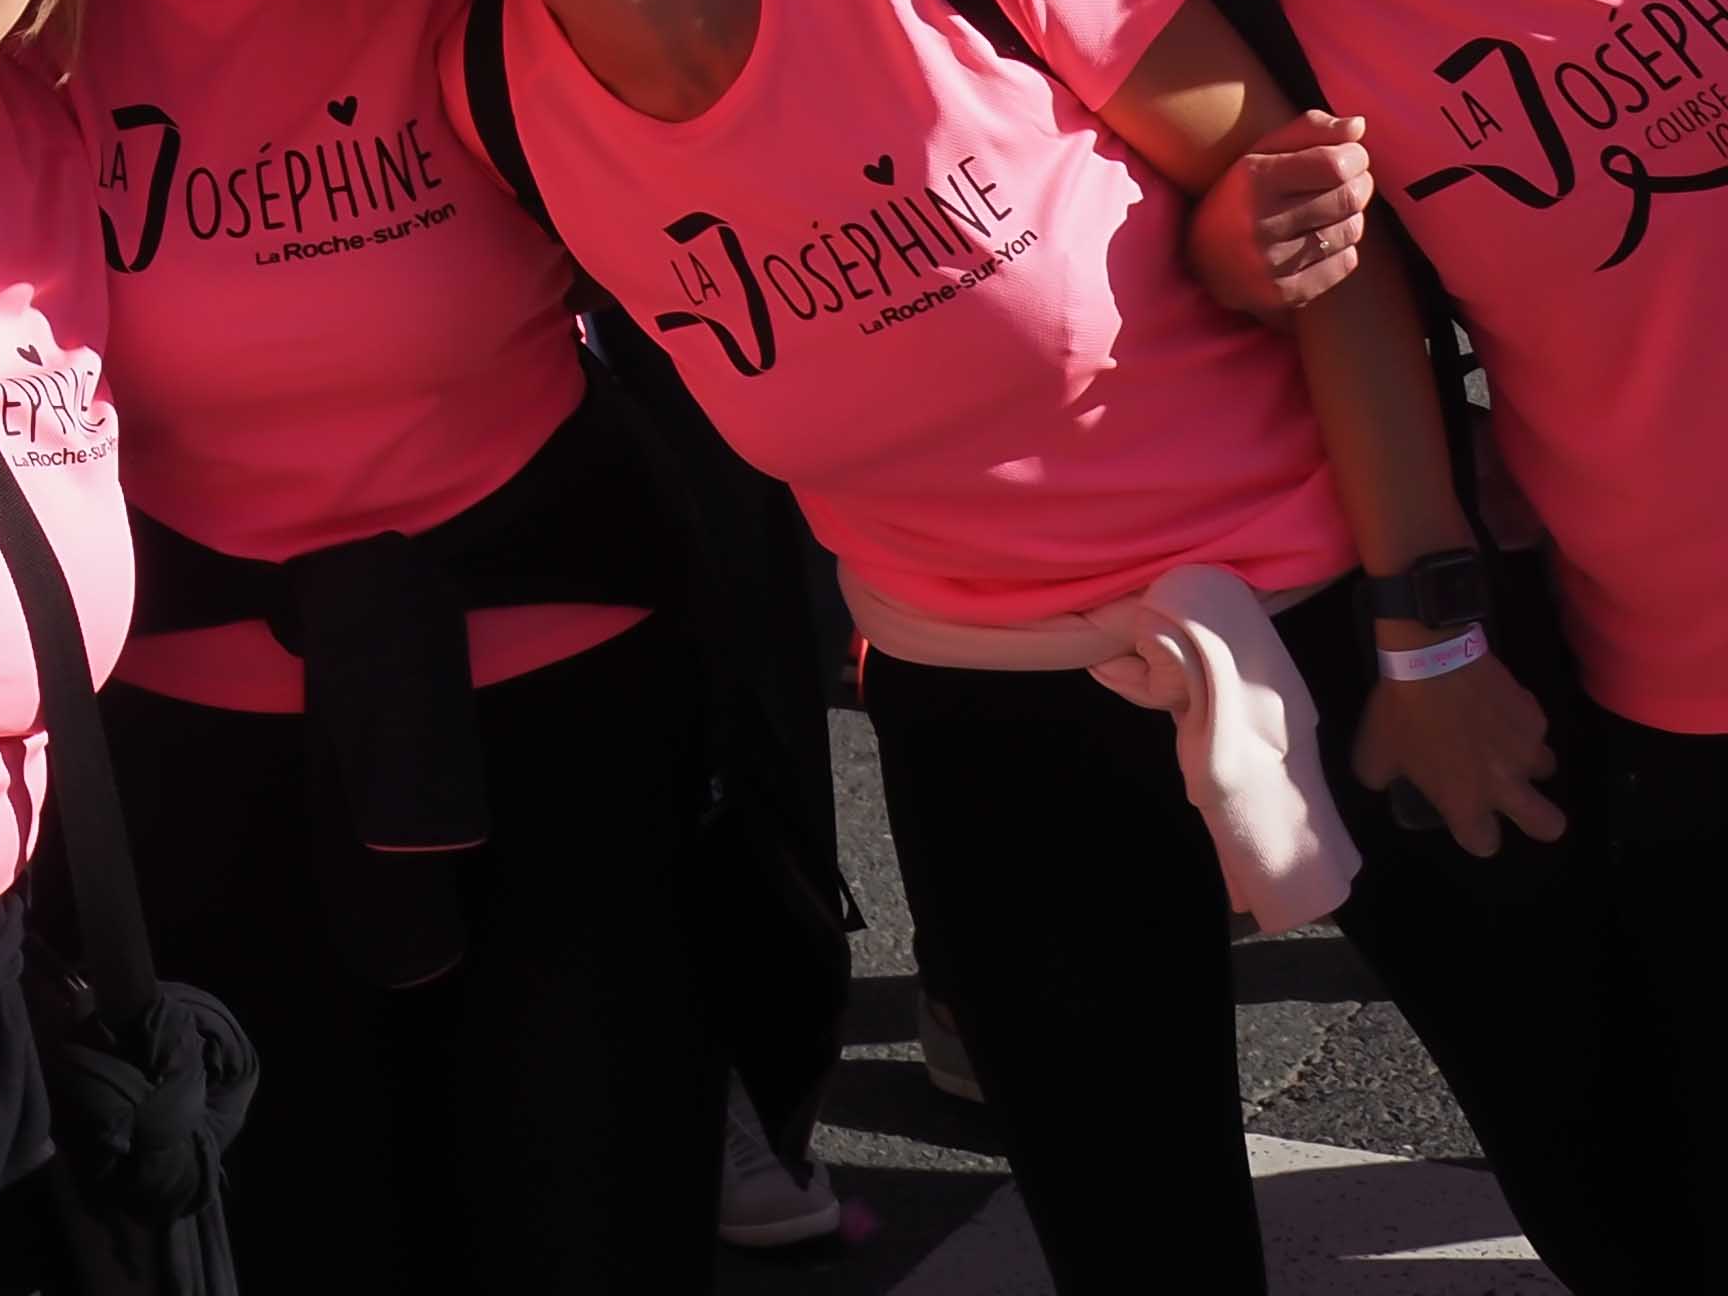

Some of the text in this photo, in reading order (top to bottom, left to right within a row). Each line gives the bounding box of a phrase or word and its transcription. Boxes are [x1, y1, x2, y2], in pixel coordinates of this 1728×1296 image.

[1440, 90, 1503, 151] LA
[98, 147, 128, 192] LA
[100, 103, 442, 273] JOSÉPHINE
[255, 201, 457, 266] La Roche-sur-Yon
[656, 155, 1012, 376] JOSÉPHINE
[671, 250, 721, 307] LA
[859, 227, 1038, 336] La Roche-sur-Yon
